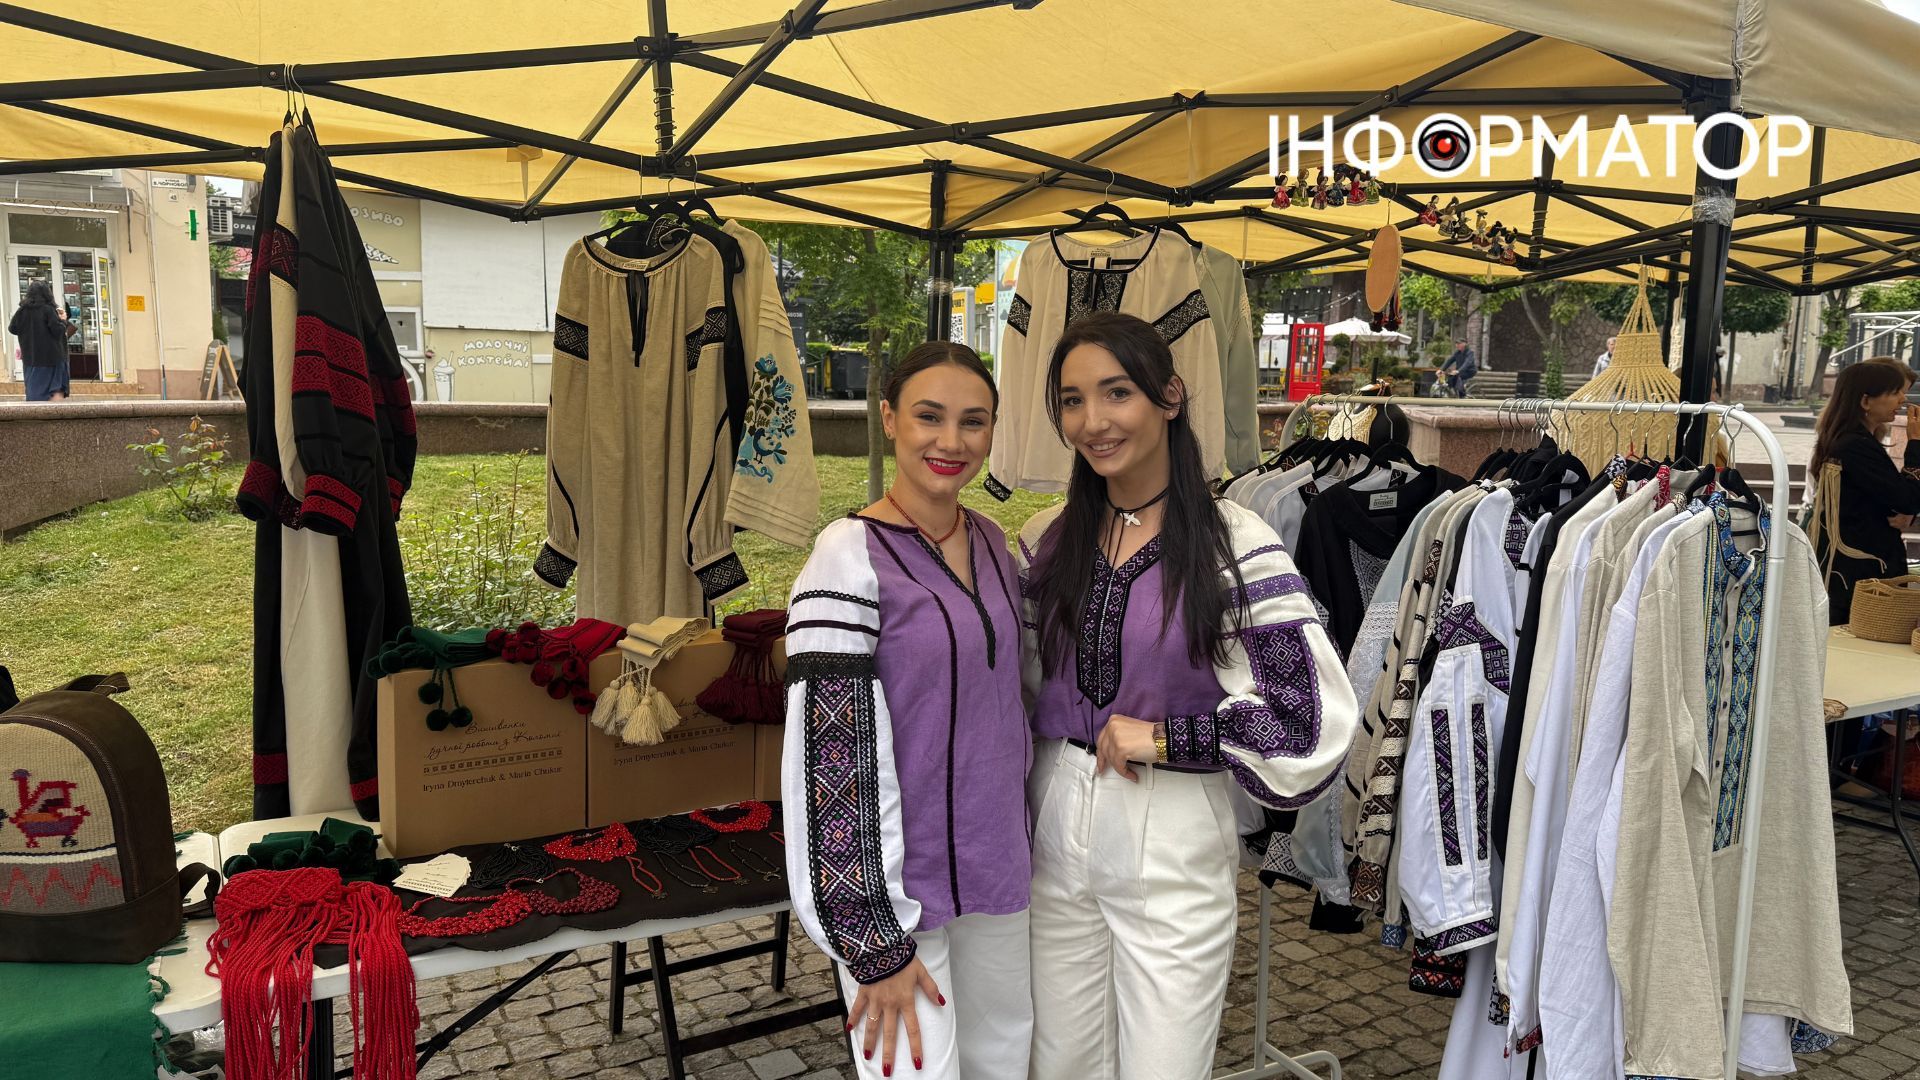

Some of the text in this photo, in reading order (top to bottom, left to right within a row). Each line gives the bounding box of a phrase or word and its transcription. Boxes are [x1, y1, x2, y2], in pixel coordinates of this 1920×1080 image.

[465, 719, 527, 734] Вишиванки
[463, 738, 498, 754] роботи
[423, 783, 445, 793] Iryna
[499, 773, 506, 781] &
[509, 770, 532, 779] Maria
[534, 766, 563, 776] Chukur
